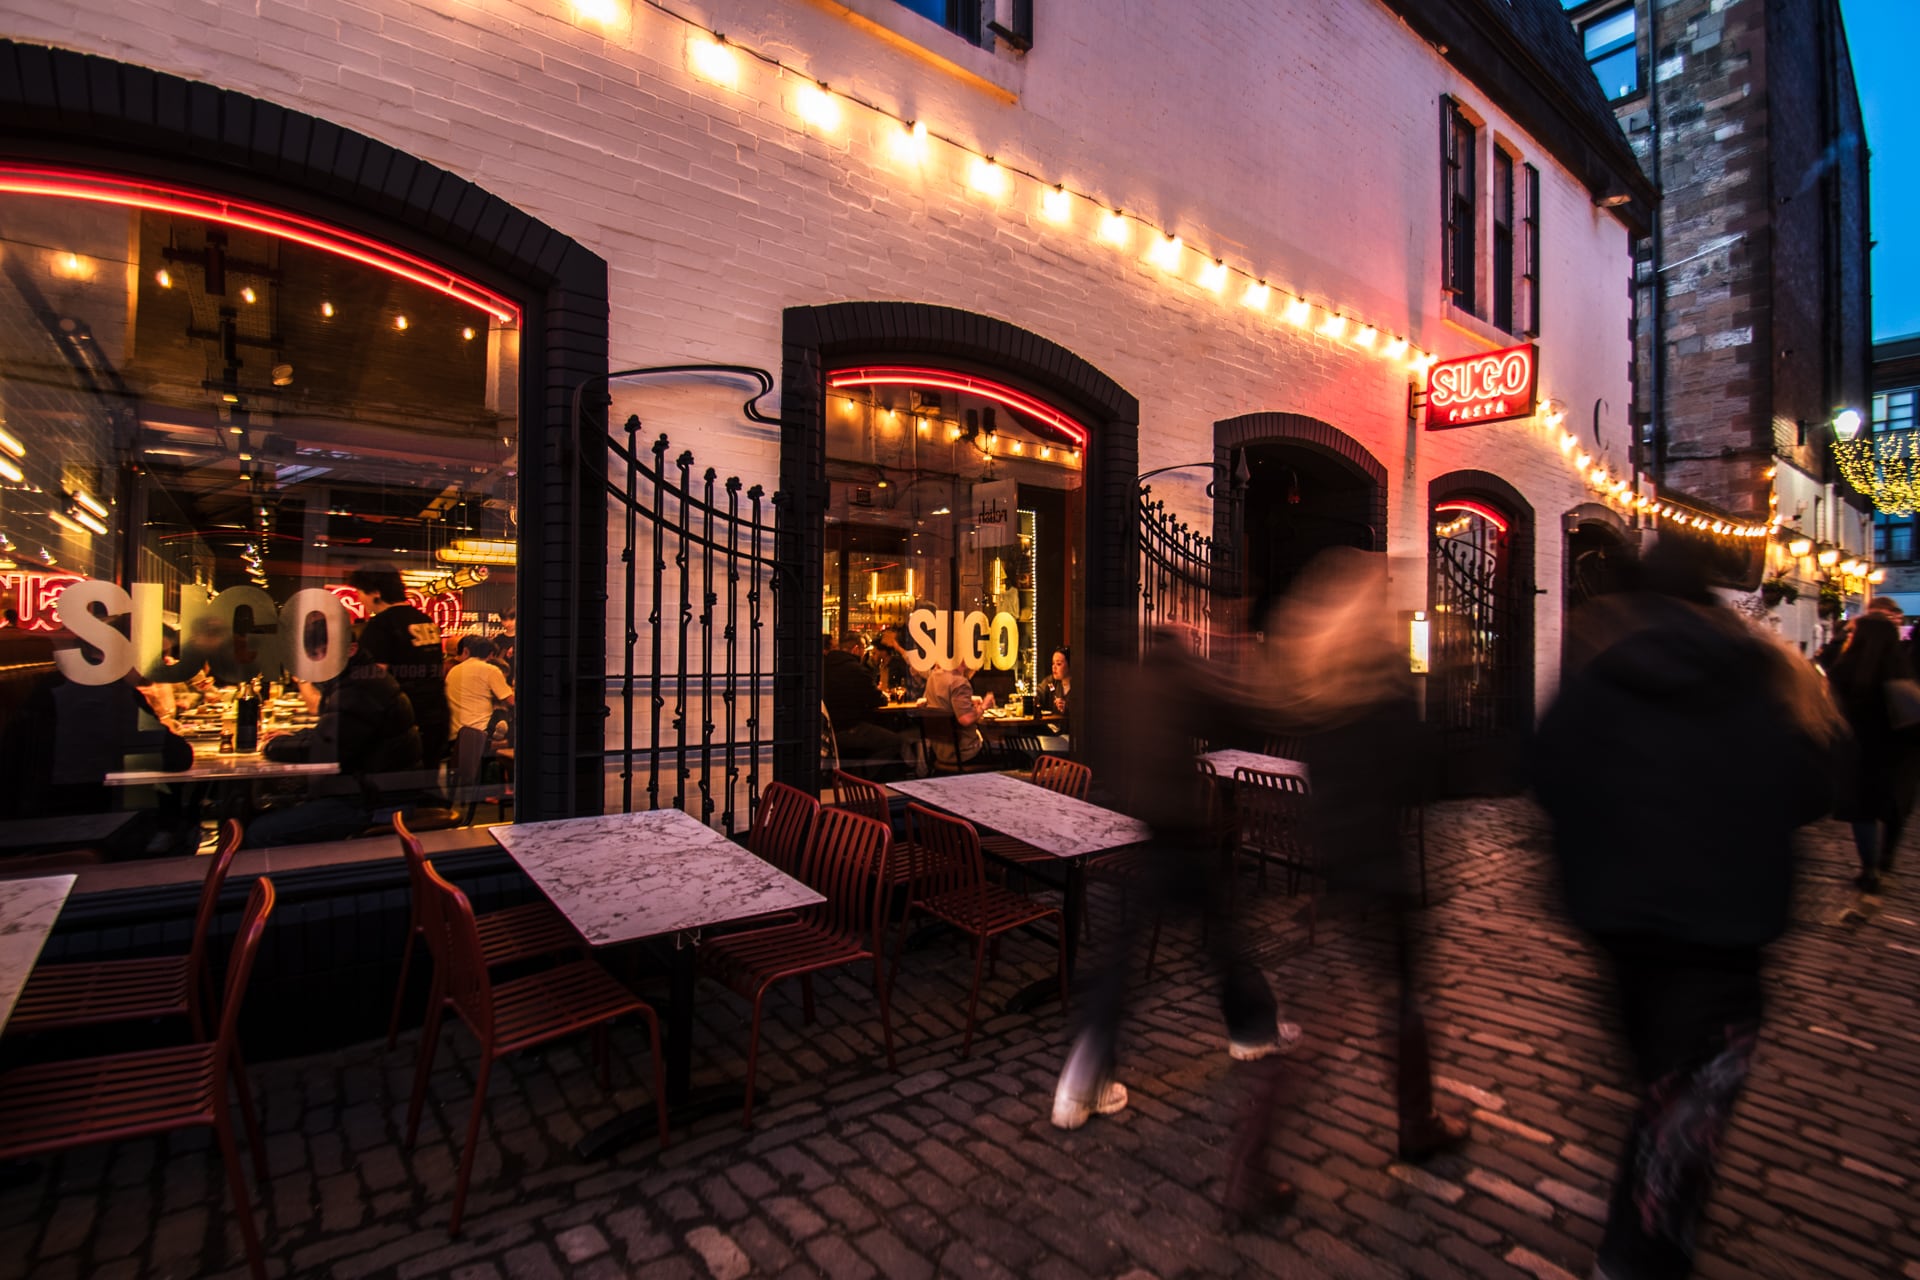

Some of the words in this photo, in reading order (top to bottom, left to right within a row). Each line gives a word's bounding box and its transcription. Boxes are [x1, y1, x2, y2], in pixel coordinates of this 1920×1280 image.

[1431, 351, 1530, 406] SUGO
[1449, 401, 1504, 421] PASTA
[54, 580, 350, 686] SUGO
[908, 608, 1018, 672] SUGO
